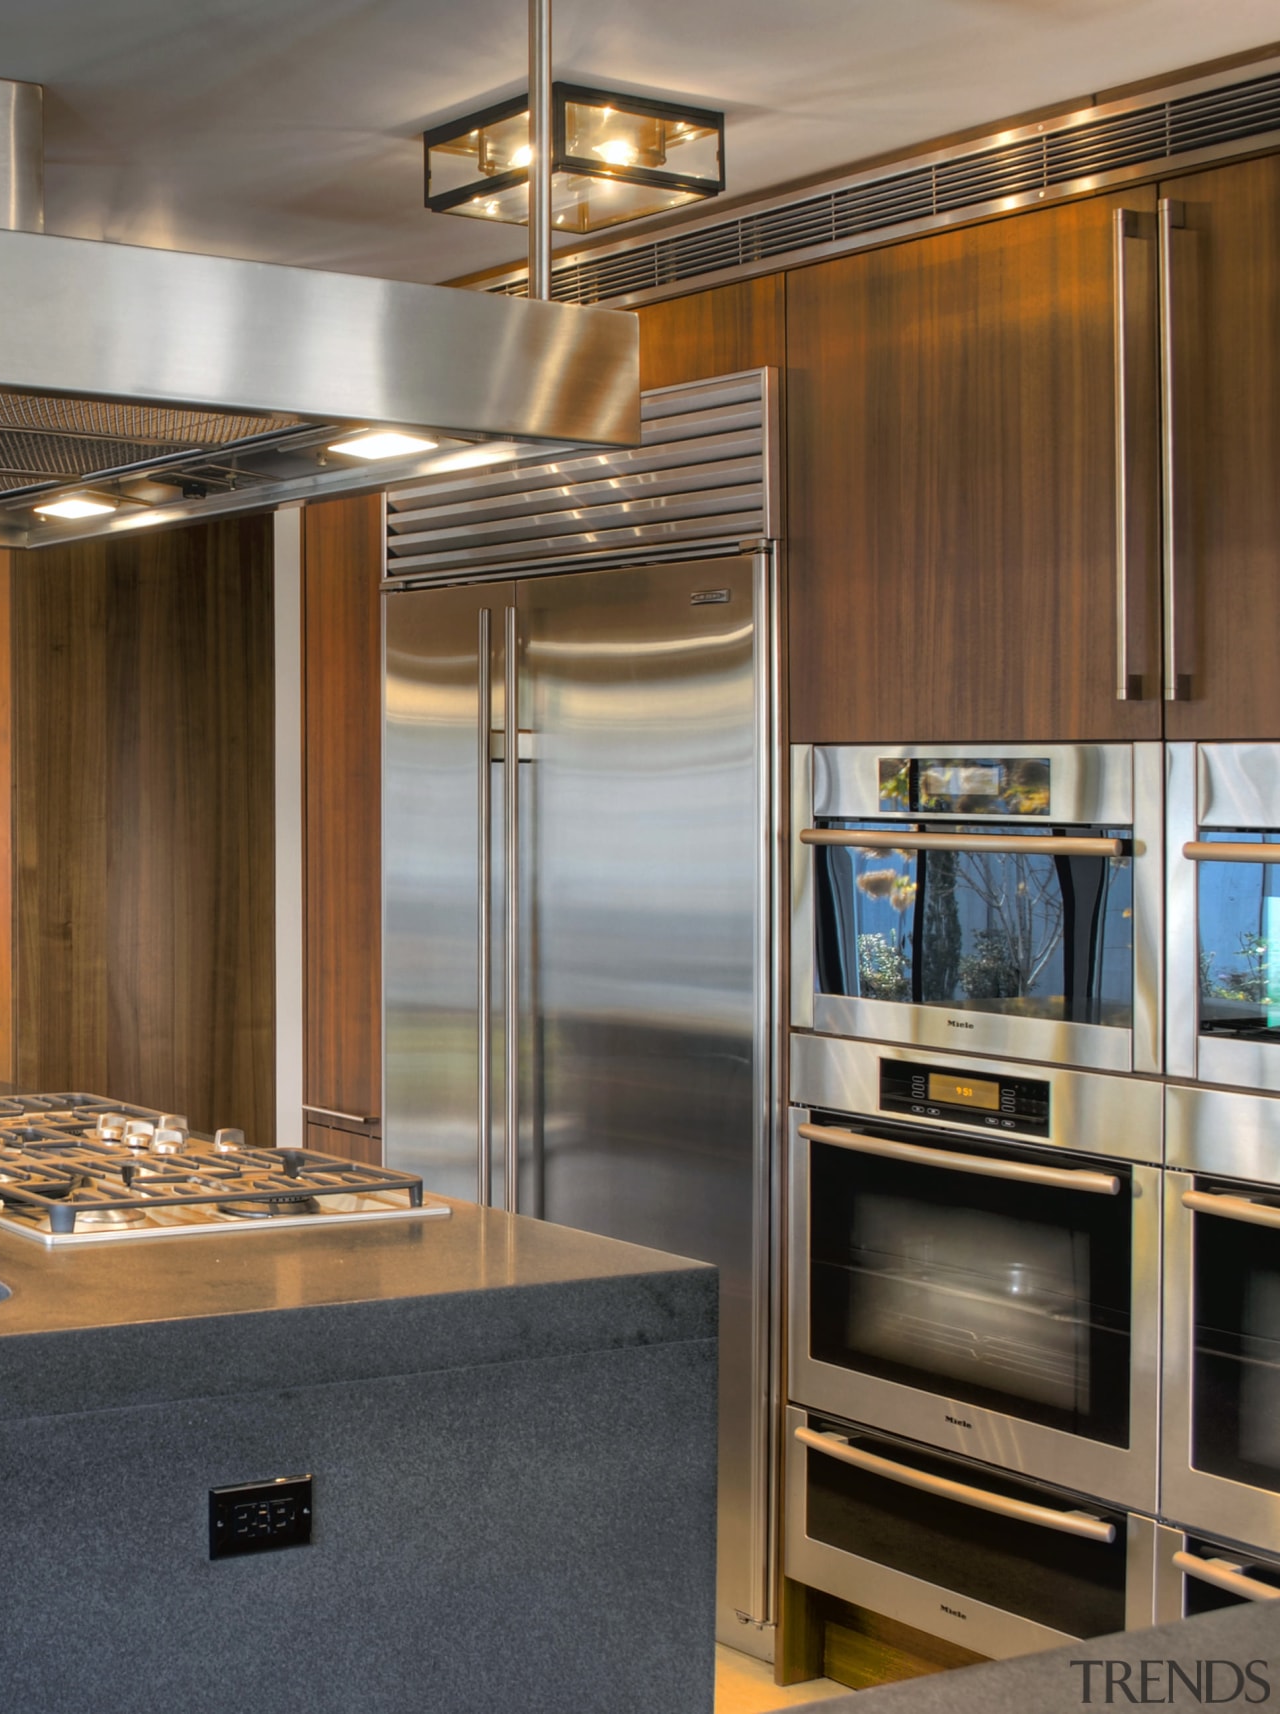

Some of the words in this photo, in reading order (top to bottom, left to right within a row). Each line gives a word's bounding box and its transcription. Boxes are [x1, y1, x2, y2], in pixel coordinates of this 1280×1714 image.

[947, 1019, 974, 1029] Miele
[945, 1415, 972, 1429] Miele
[940, 1604, 966, 1620] Miele
